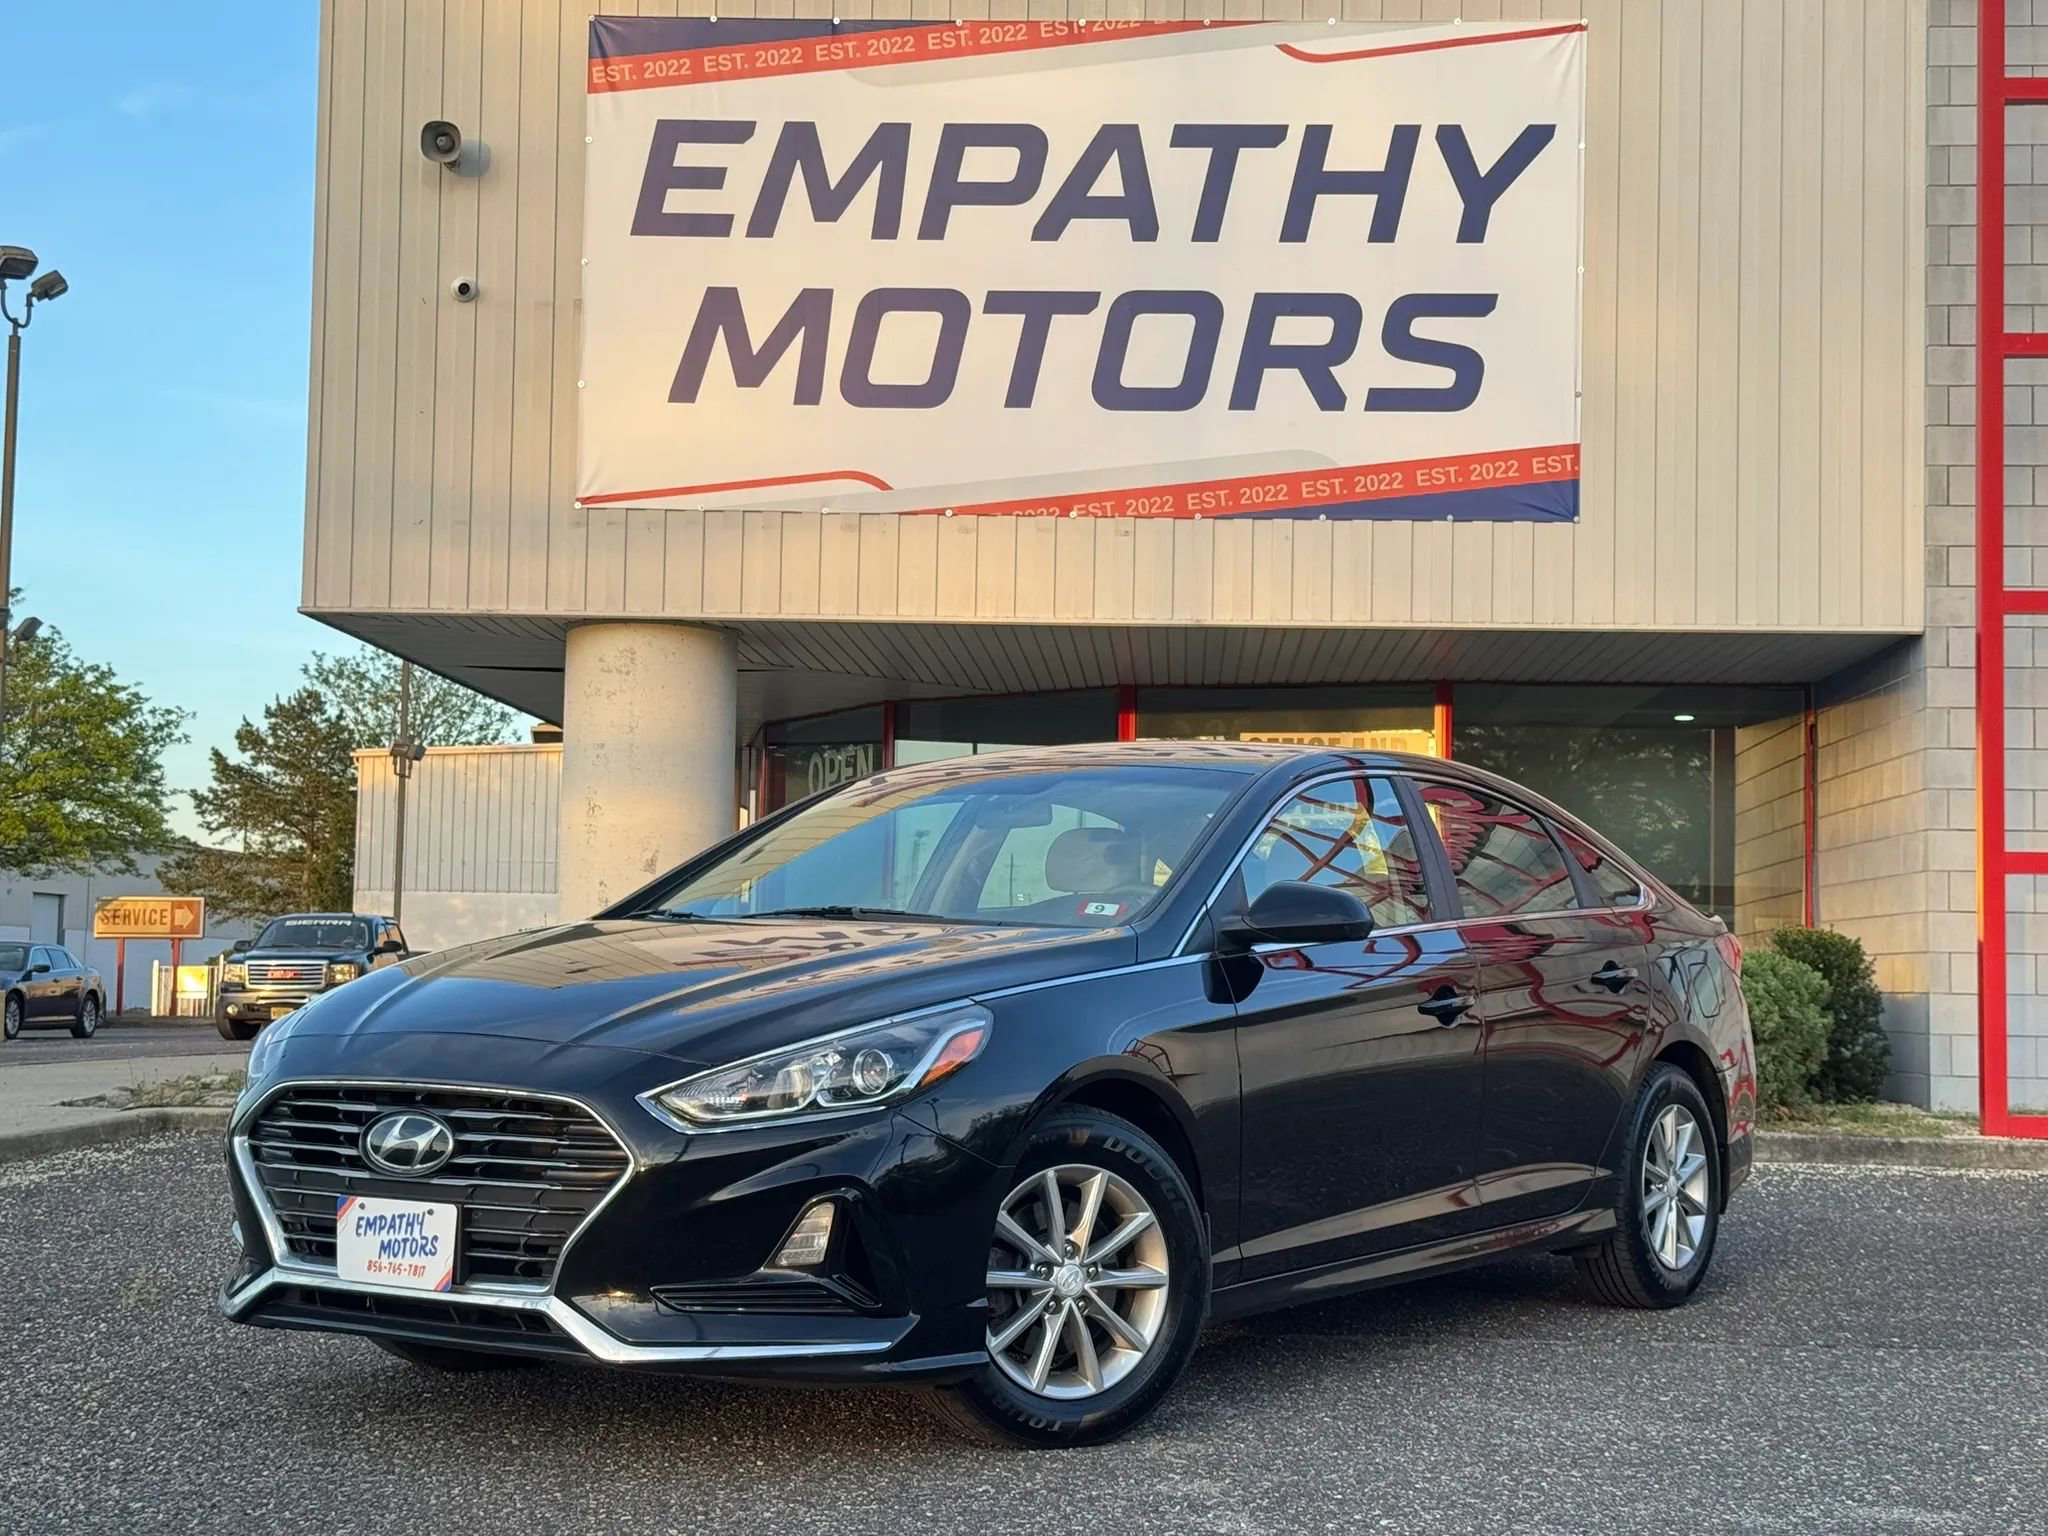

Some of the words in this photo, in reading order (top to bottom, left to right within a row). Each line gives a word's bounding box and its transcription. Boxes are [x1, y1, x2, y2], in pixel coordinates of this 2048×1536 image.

[592, 63, 636, 83] EST.
[643, 58, 692, 79] 2022
[703, 53, 748, 73] EST.
[755, 47, 803, 68] 2022
[815, 43, 860, 62] EST.
[867, 36, 915, 57] 2022
[927, 29, 972, 50] EST.
[979, 23, 1028, 45] 2022
[629, 118, 1556, 243] EMPATHY
[667, 286, 1498, 411] MOTORS
[1125, 496, 1174, 516] 2022
[1187, 490, 1232, 510] EST.
[1239, 484, 1288, 504] 2022
[1301, 478, 1347, 498] EST.
[1354, 472, 1403, 493] 2022
[1416, 466, 1463, 486] EST.
[1469, 460, 1519, 481] 2022
[1532, 454, 1579, 474] EST.
[808, 744, 873, 794] OPEN
[100, 908, 168, 926] SERVICE
[355, 1211, 426, 1237] EMPATHY
[378, 1234, 439, 1260] MOTORS
